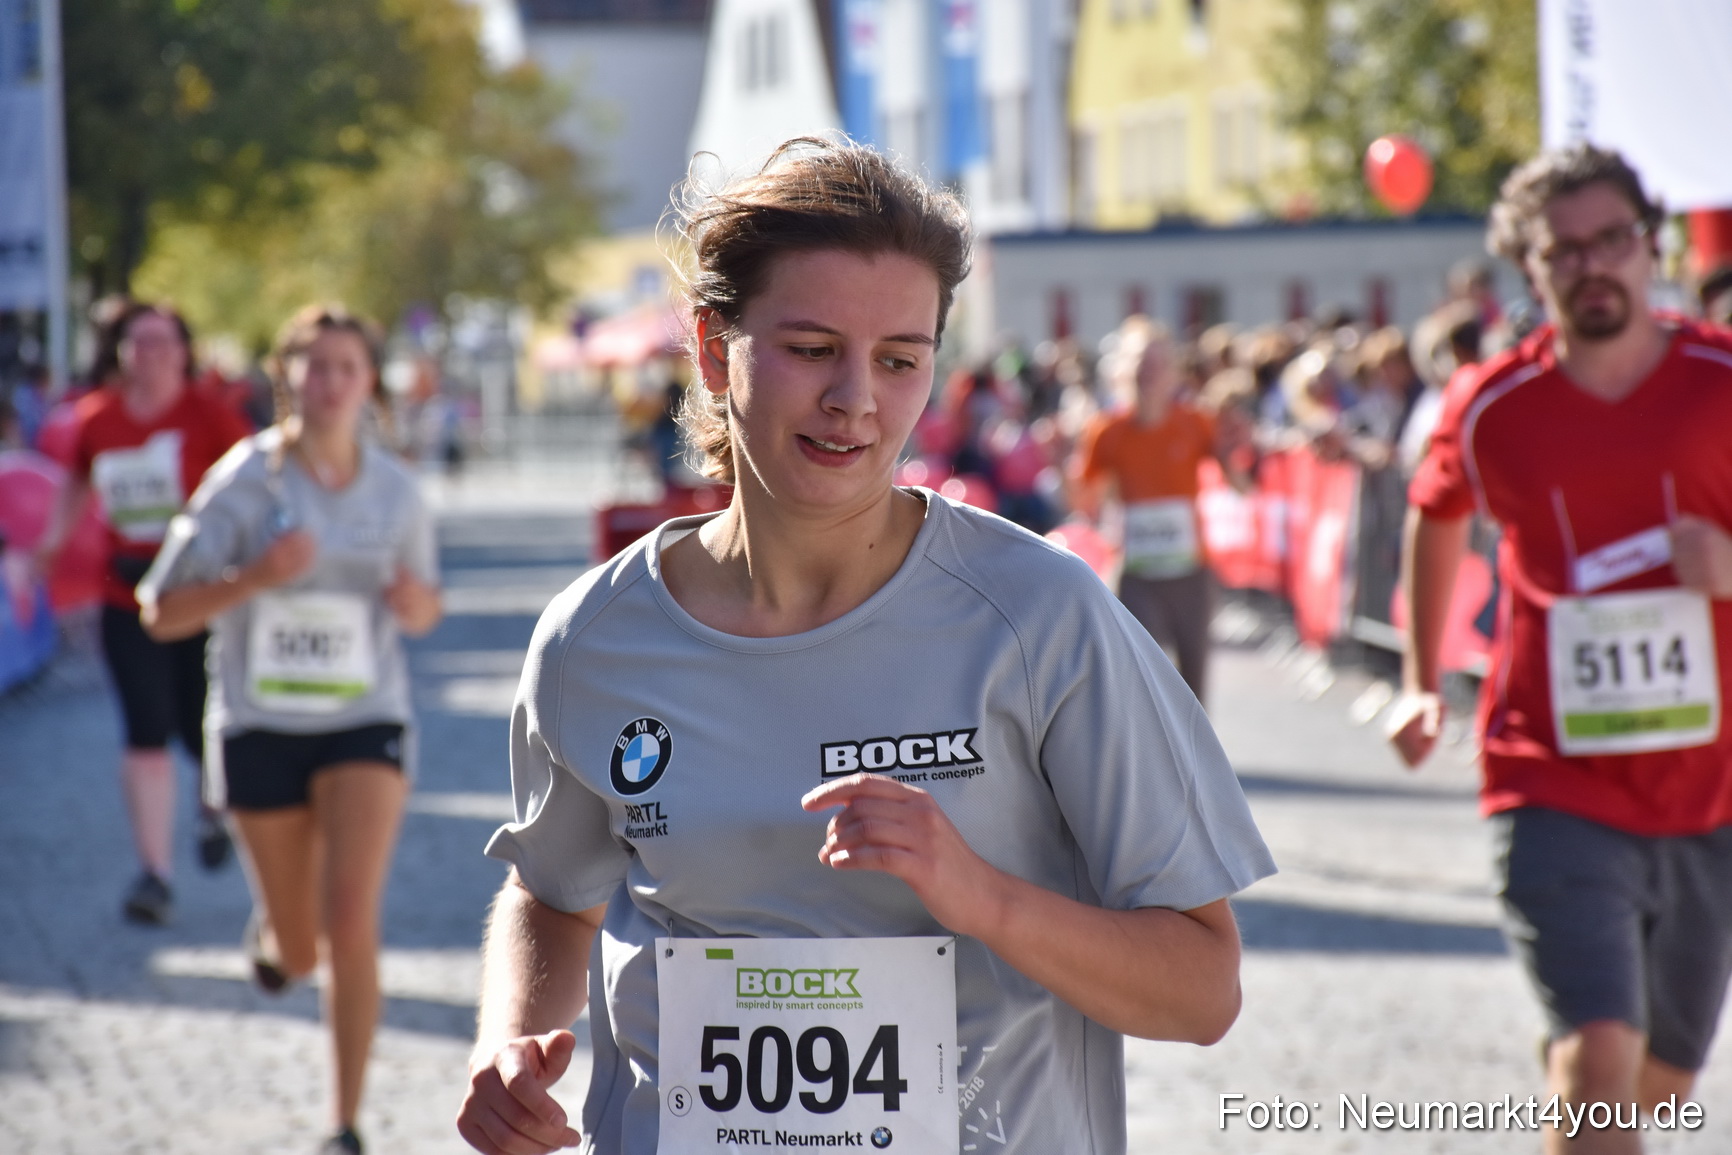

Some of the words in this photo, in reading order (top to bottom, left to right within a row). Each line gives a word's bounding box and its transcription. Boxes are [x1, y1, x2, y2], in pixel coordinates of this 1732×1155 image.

[1573, 634, 1688, 689] 5114
[617, 720, 668, 751] BMW
[822, 730, 981, 775] BOCK
[932, 766, 985, 781] concepts
[624, 801, 667, 824] PARTL
[624, 822, 668, 839] Neumarkt
[736, 968, 862, 998] BOCK
[736, 1000, 771, 1011] inspired
[772, 1000, 784, 1011] by
[785, 1001, 814, 1010] smart
[816, 1001, 864, 1011] concepts
[698, 1025, 908, 1114] 5094
[675, 1093, 684, 1110] S
[960, 1076, 985, 1109] 2018
[716, 1128, 771, 1146] PARTL
[775, 1130, 862, 1147] Neumarkt
